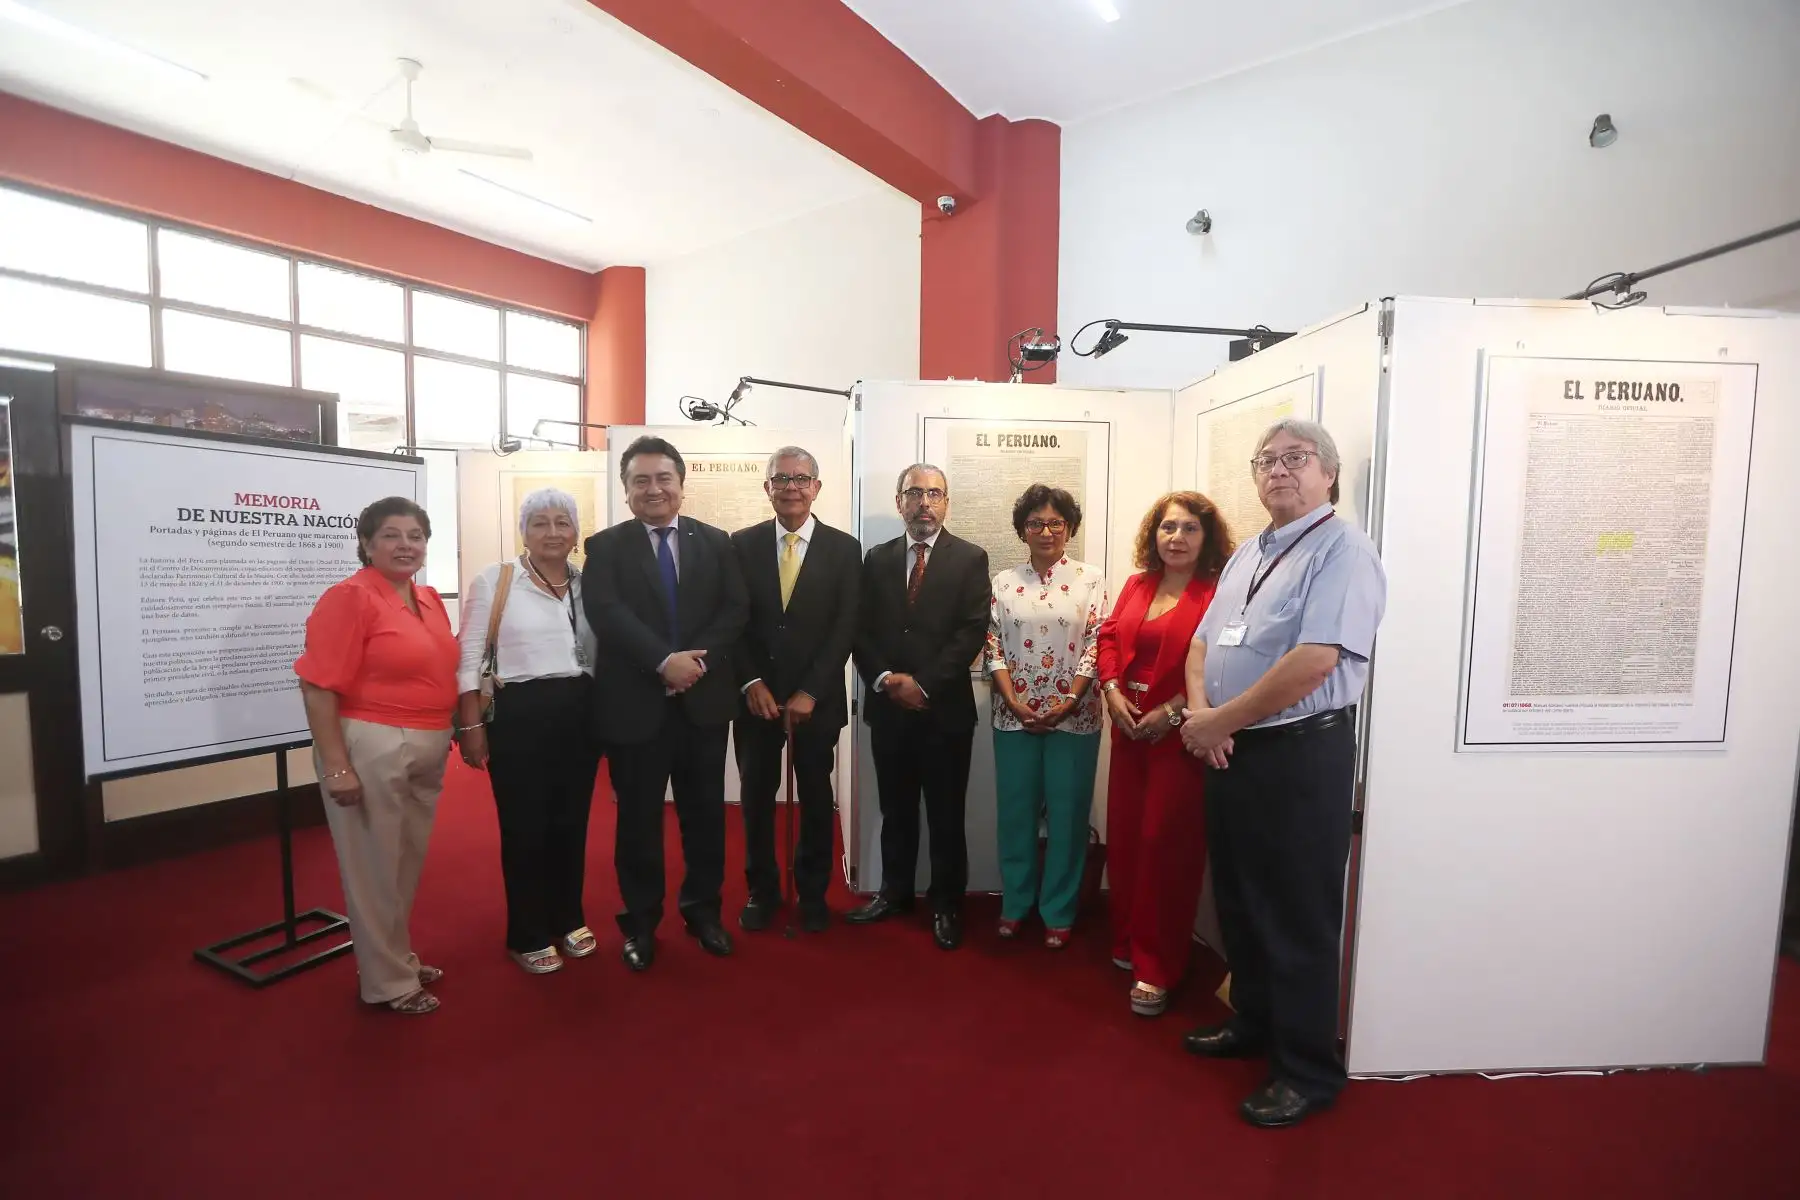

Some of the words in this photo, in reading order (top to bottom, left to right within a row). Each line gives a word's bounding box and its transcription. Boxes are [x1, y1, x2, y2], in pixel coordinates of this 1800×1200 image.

[1563, 380, 1585, 400] EL
[1594, 381, 1684, 403] PERUANO.
[976, 433, 991, 447] EL
[997, 433, 1061, 449] PERUANO.
[691, 463, 706, 472] EL
[709, 463, 760, 473] PERUANO.
[234, 492, 321, 511] MEMORIA
[177, 507, 206, 522] DE
[209, 509, 299, 527] NUESTRA
[149, 525, 193, 535] Portadas
[195, 529, 201, 537] y
[202, 528, 238, 538] páginas
[239, 528, 250, 537] de
[251, 529, 260, 537] El
[262, 530, 297, 539] Peruano
[298, 533, 312, 541] que
[207, 539, 247, 548] (segundo
[286, 540, 297, 548] de
[299, 541, 316, 549] 1868
[324, 542, 344, 550] 1900)
